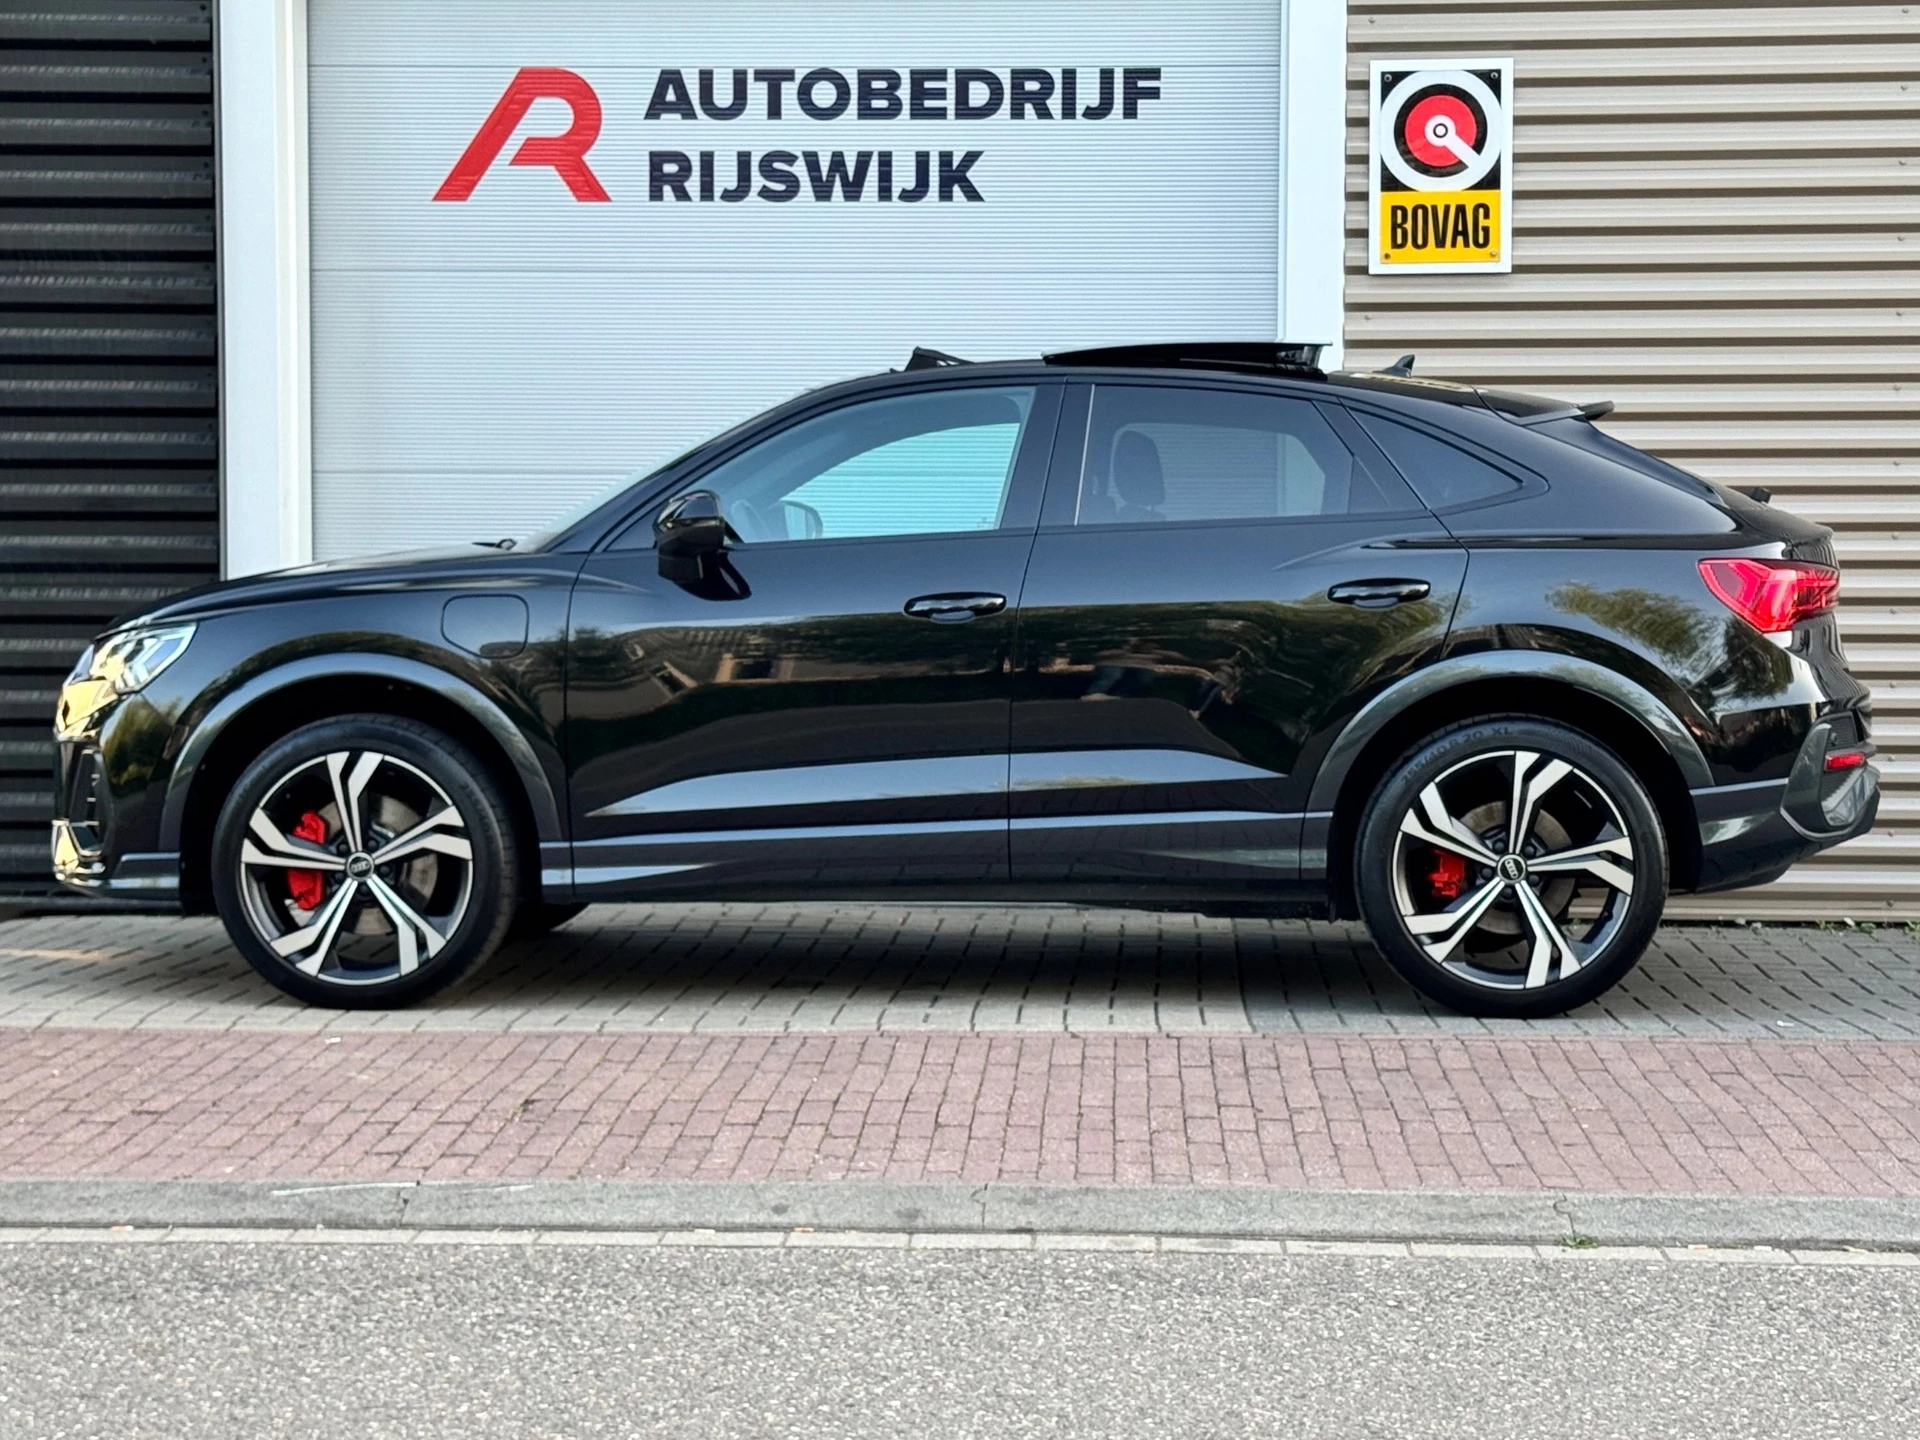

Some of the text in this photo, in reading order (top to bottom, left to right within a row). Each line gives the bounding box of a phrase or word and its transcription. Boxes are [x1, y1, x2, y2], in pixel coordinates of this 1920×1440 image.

[644, 68, 1161, 121] AUTOBEDRIJF
[649, 150, 985, 202] RIJSWIJK
[1391, 203, 1490, 250] BOVAG
[1491, 726, 1514, 737] XL
